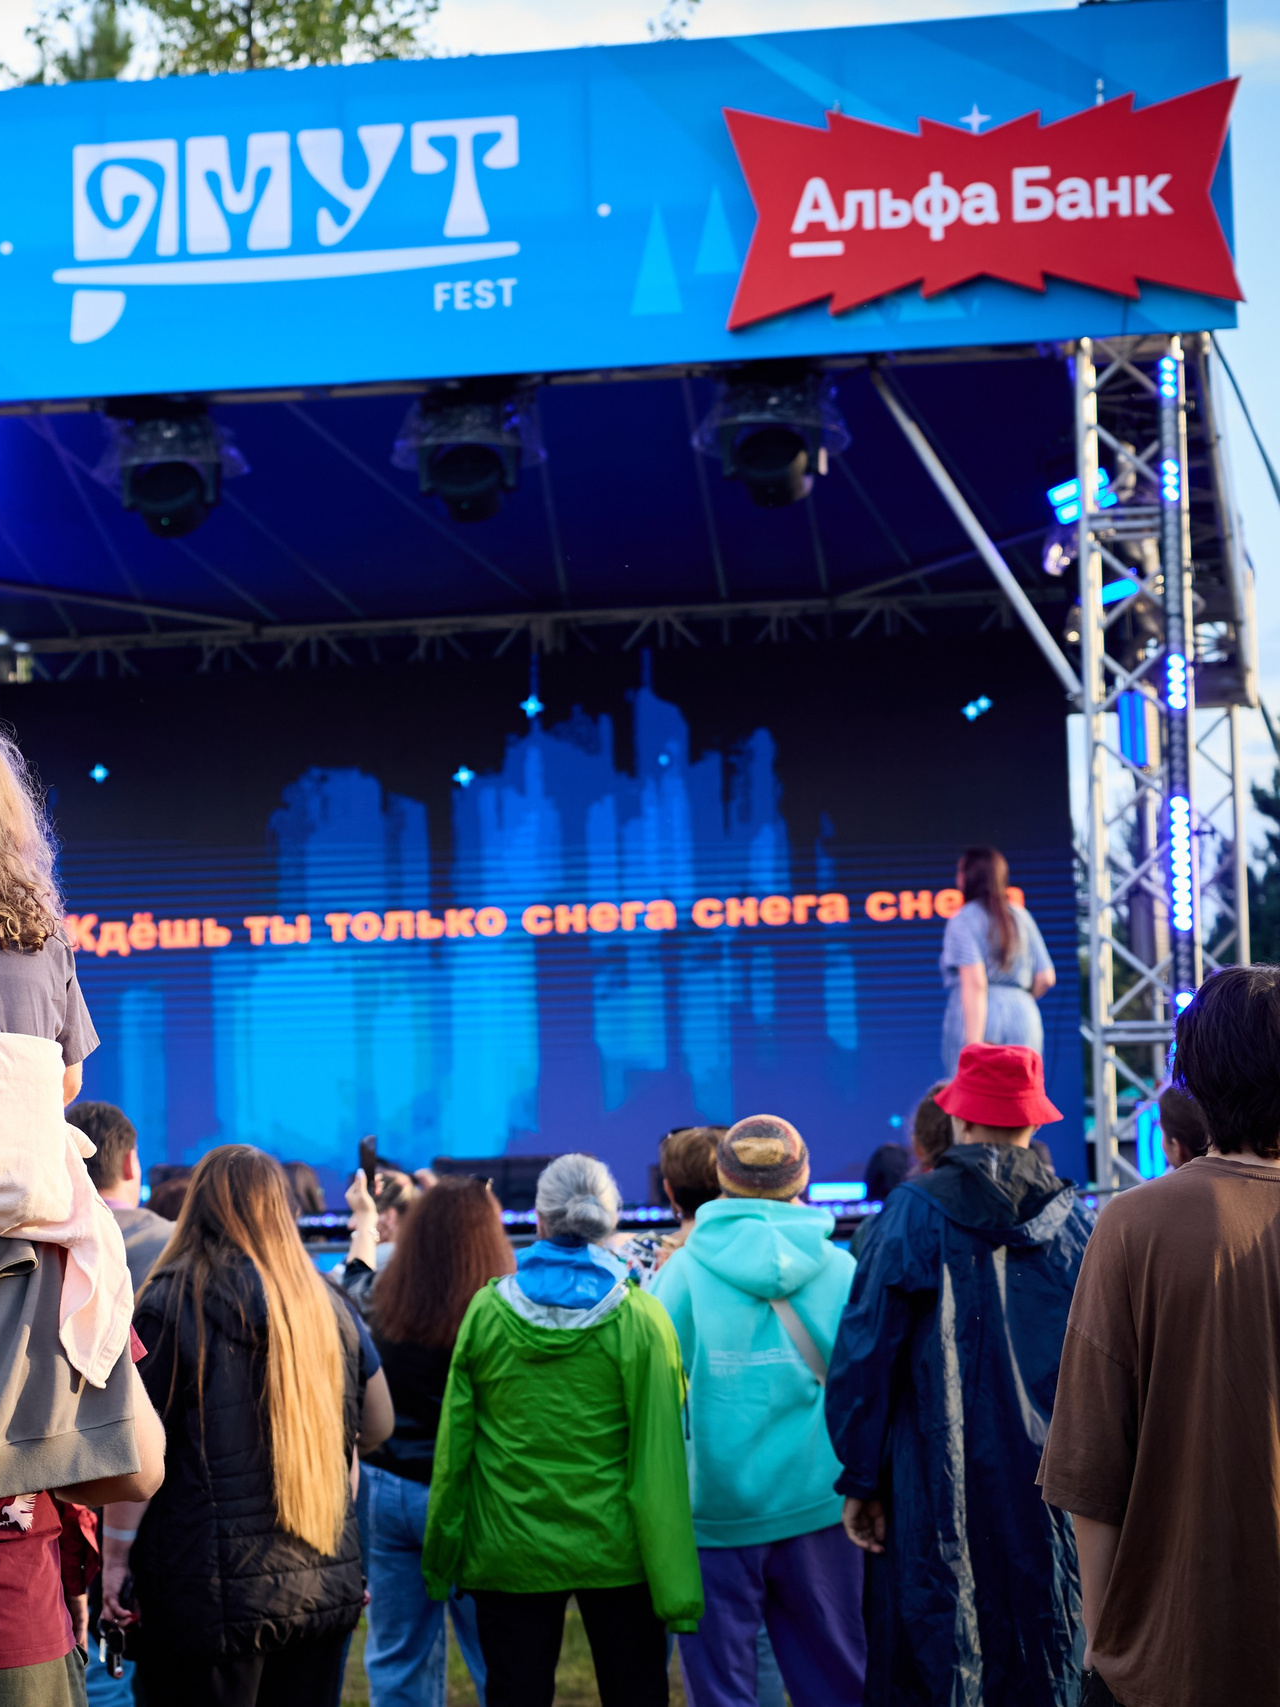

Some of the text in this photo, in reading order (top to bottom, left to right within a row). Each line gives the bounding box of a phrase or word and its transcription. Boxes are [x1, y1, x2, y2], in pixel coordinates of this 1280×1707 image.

[790, 165, 1175, 242] Альфа Банк
[433, 277, 518, 311] FEST
[243, 914, 311, 946] ты
[325, 906, 508, 943] только
[521, 899, 677, 936] снега
[691, 892, 850, 929] снега
[864, 886, 1025, 922] сне
